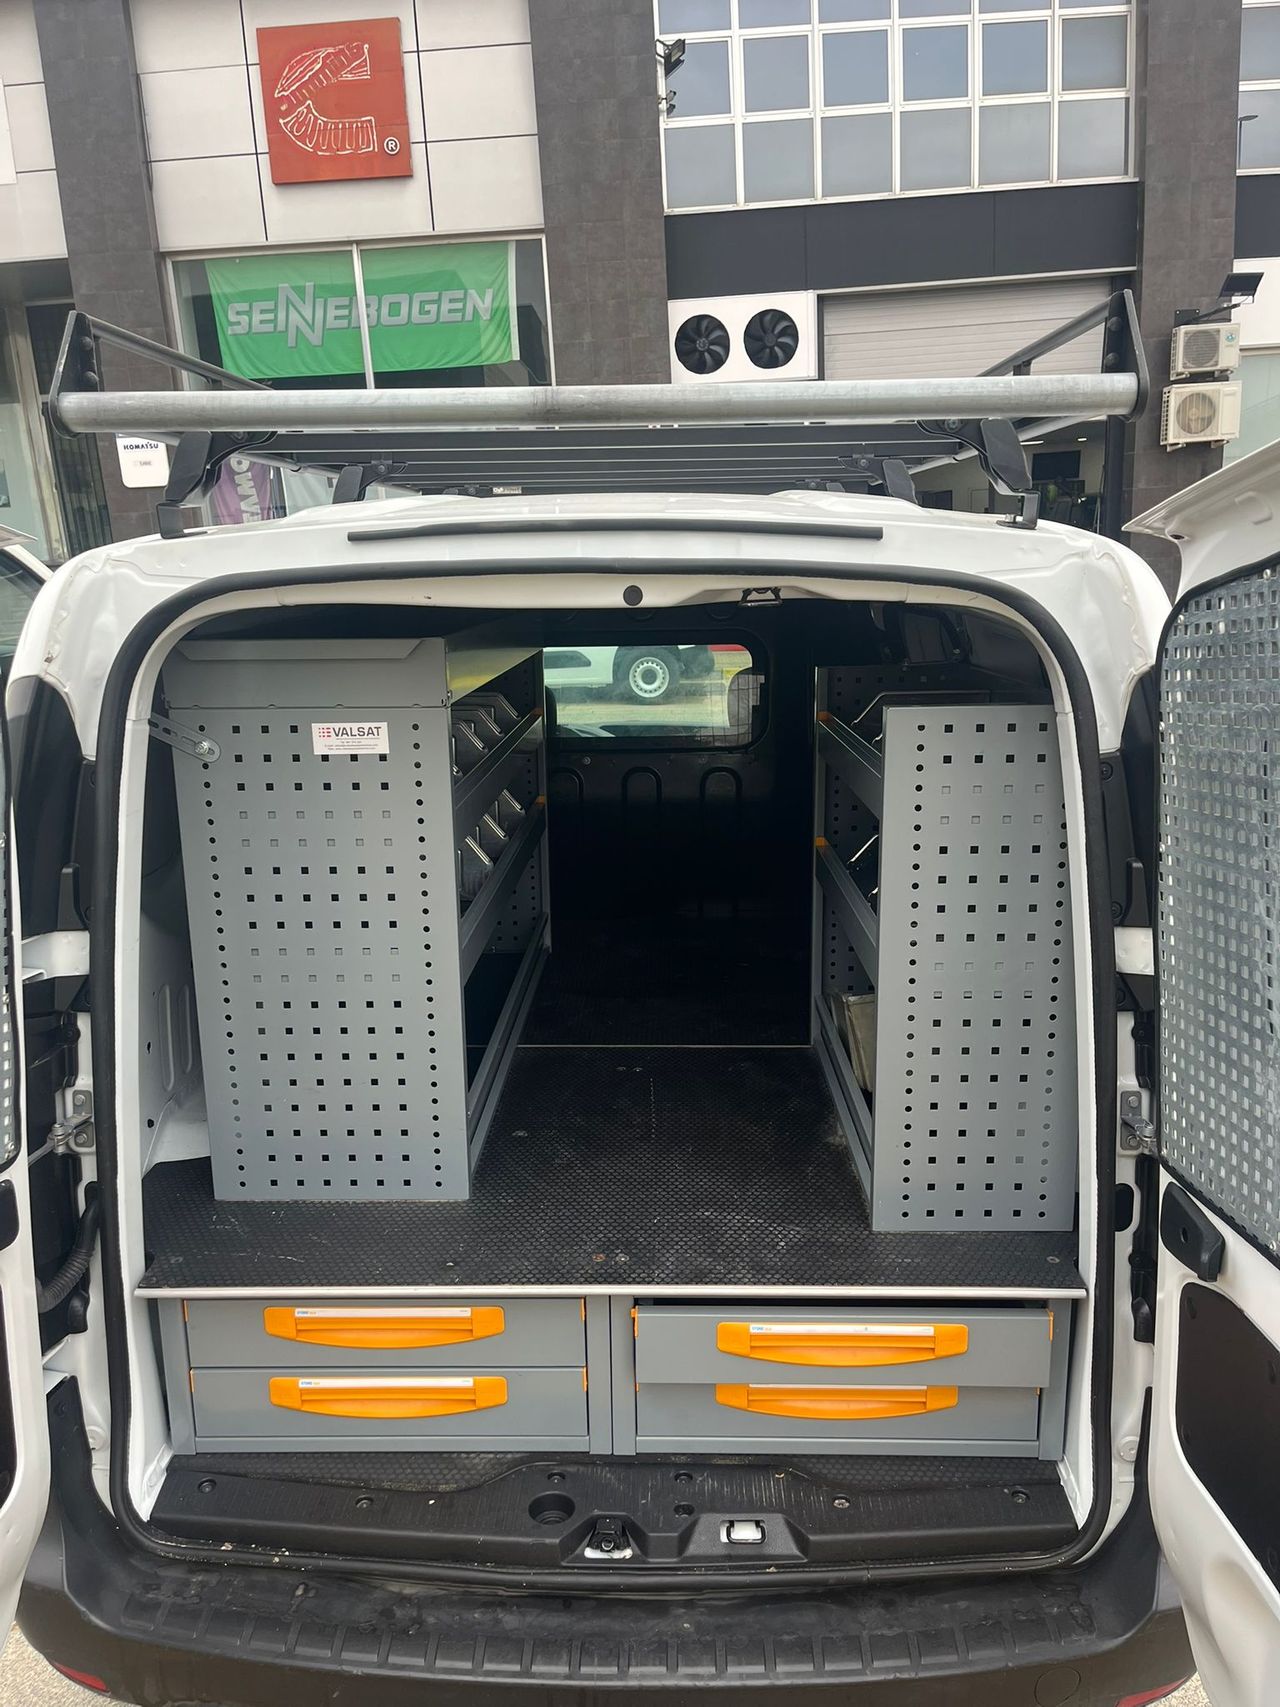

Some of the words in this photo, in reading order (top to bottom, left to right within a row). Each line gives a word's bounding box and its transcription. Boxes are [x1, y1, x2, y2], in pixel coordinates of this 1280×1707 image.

[227, 282, 494, 348] SENNEBOGEN
[123, 441, 159, 450] KOMATSU
[332, 726, 382, 737] VALSAT
